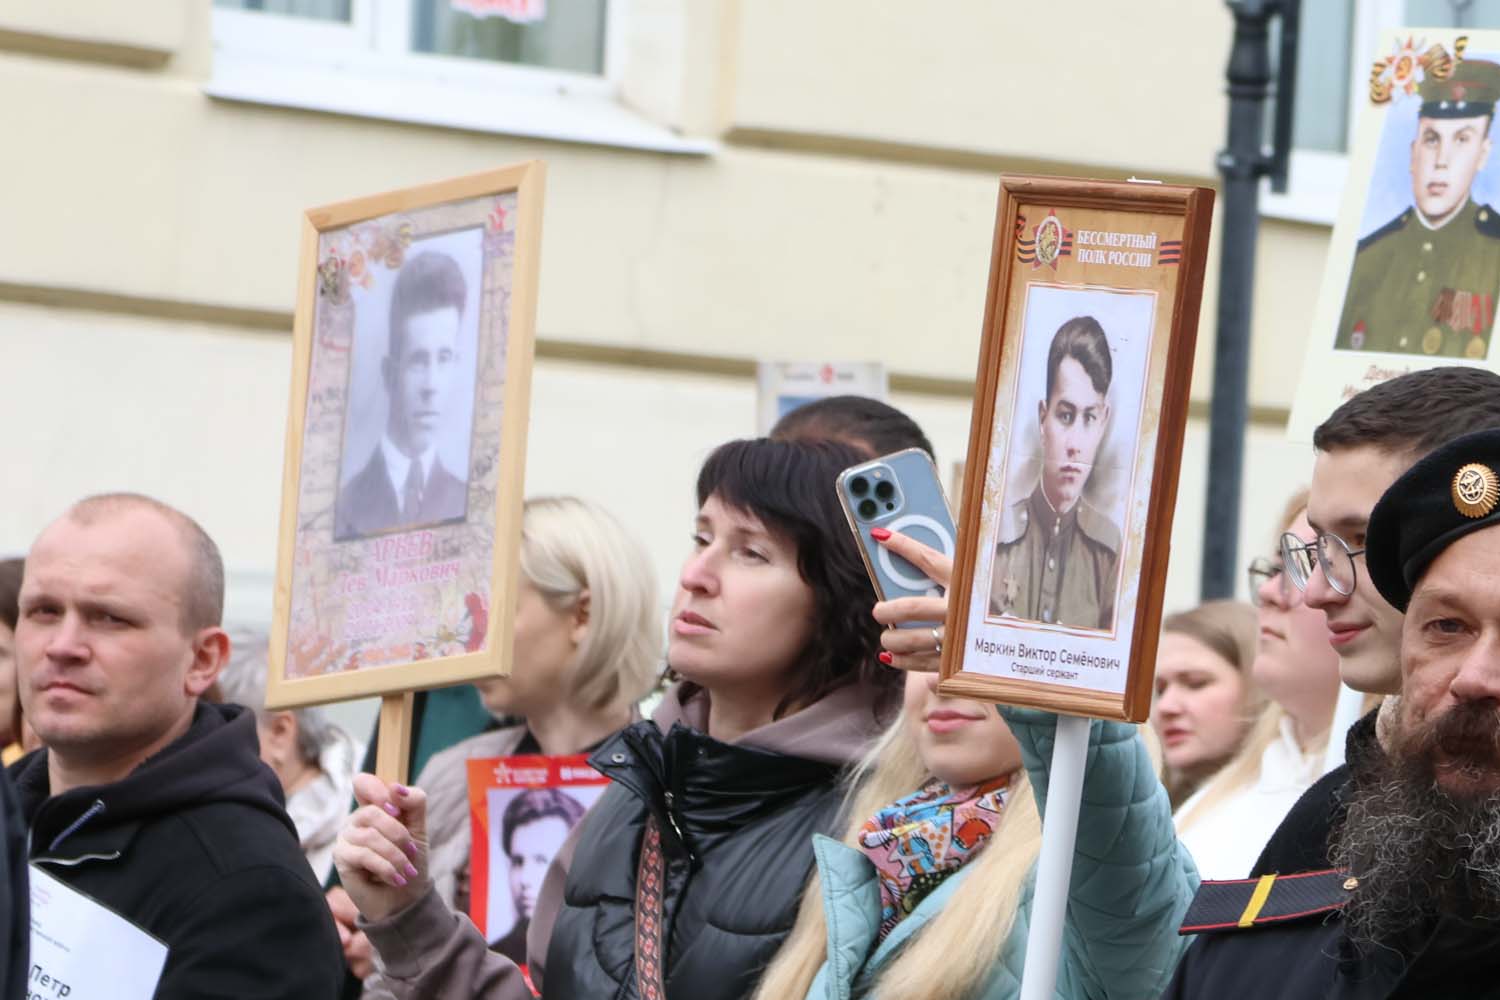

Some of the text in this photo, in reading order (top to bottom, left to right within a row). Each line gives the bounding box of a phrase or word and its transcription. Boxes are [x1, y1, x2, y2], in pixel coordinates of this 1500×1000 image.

[1077, 230, 1157, 249] БЕССМЕРТНЫЙ
[1078, 249, 1152, 267] ПОЛК РОССИИ
[975, 638, 1120, 671] Маркин Виктор Семёнович
[1011, 662, 1079, 681] Старший сержант
[30, 964, 72, 998] Петр
